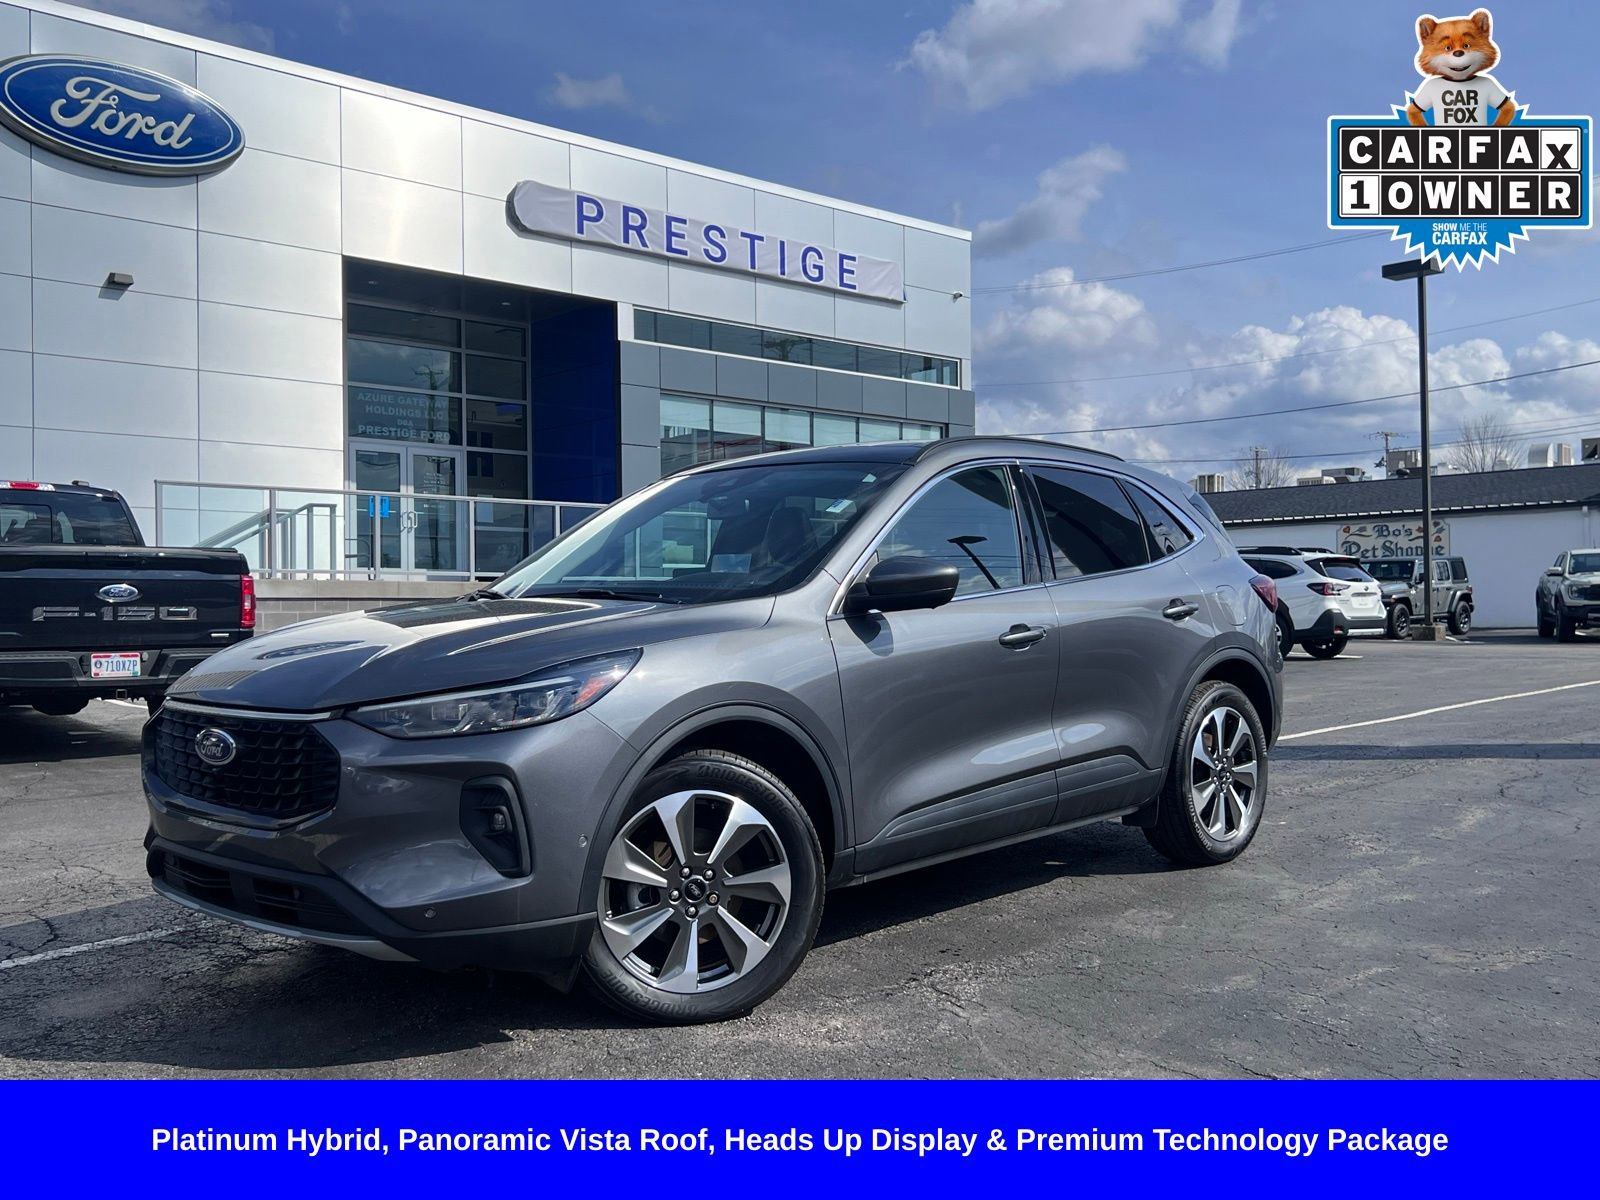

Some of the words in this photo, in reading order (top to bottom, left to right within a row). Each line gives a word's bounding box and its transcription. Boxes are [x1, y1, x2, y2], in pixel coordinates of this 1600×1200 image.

[50, 76, 195, 149] Ford
[576, 194, 857, 290] PRESTIGE
[358, 392, 396, 404] AZURE
[398, 396, 448, 409] GATEWAY
[365, 404, 422, 418] HOLDINGS
[424, 410, 444, 420] LLC
[358, 425, 417, 438] PRESTIGE
[420, 430, 451, 441] FORD
[1372, 524, 1413, 538] Bo's
[1340, 540, 1379, 559] Pet
[1381, 540, 1445, 558] Shope
[32, 605, 198, 622] F-150
[600, 969, 700, 1018] BRIDGESTONE
